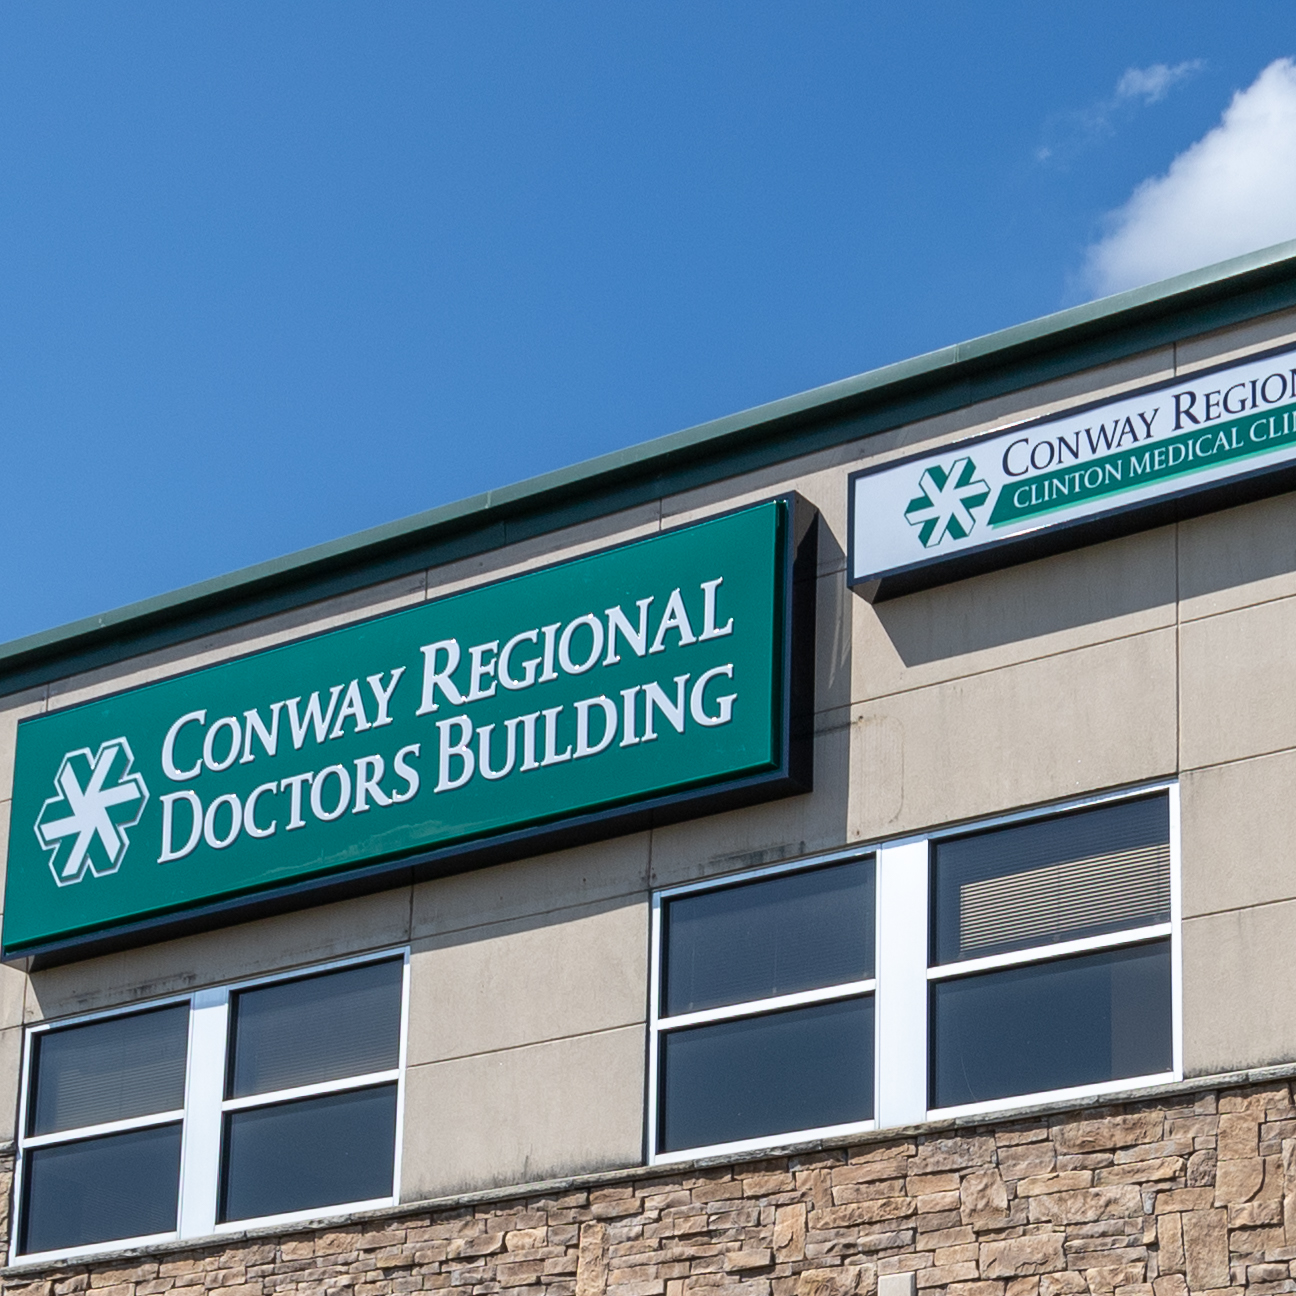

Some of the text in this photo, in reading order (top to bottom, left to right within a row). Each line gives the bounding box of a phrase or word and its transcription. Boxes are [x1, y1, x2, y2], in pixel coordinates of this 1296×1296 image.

[1002, 406, 1161, 478] CONWAY
[1013, 459, 1124, 511] CLINTON
[1129, 428, 1245, 479] MEDICAL
[160, 576, 735, 783] CONWAY REGIONAL
[157, 663, 738, 865] DOCTORS BUILDING
